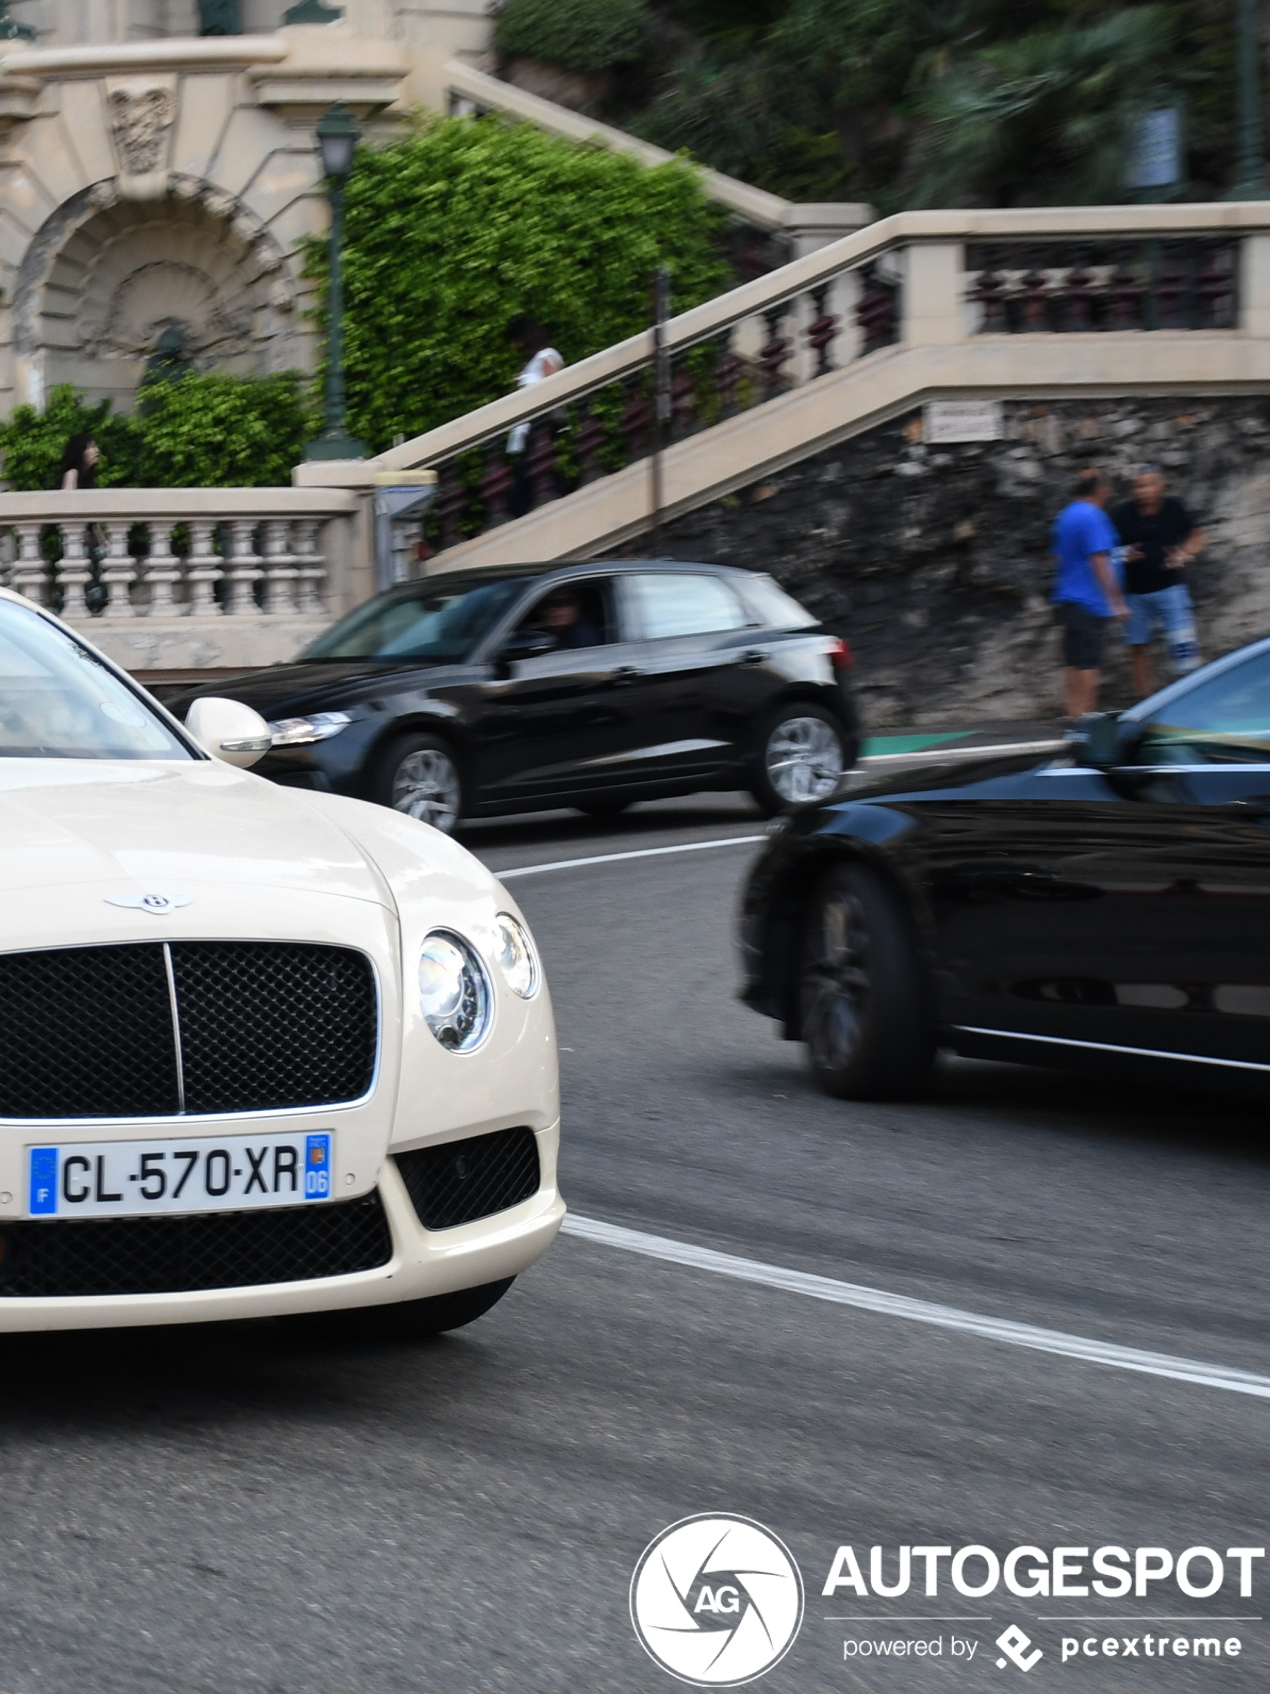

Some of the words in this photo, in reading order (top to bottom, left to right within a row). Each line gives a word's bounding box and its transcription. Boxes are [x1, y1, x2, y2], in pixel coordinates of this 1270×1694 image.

[36, 1188, 50, 1203] F
[63, 1145, 299, 1203] CL-570-XR
[306, 1170, 328, 1194] 06
